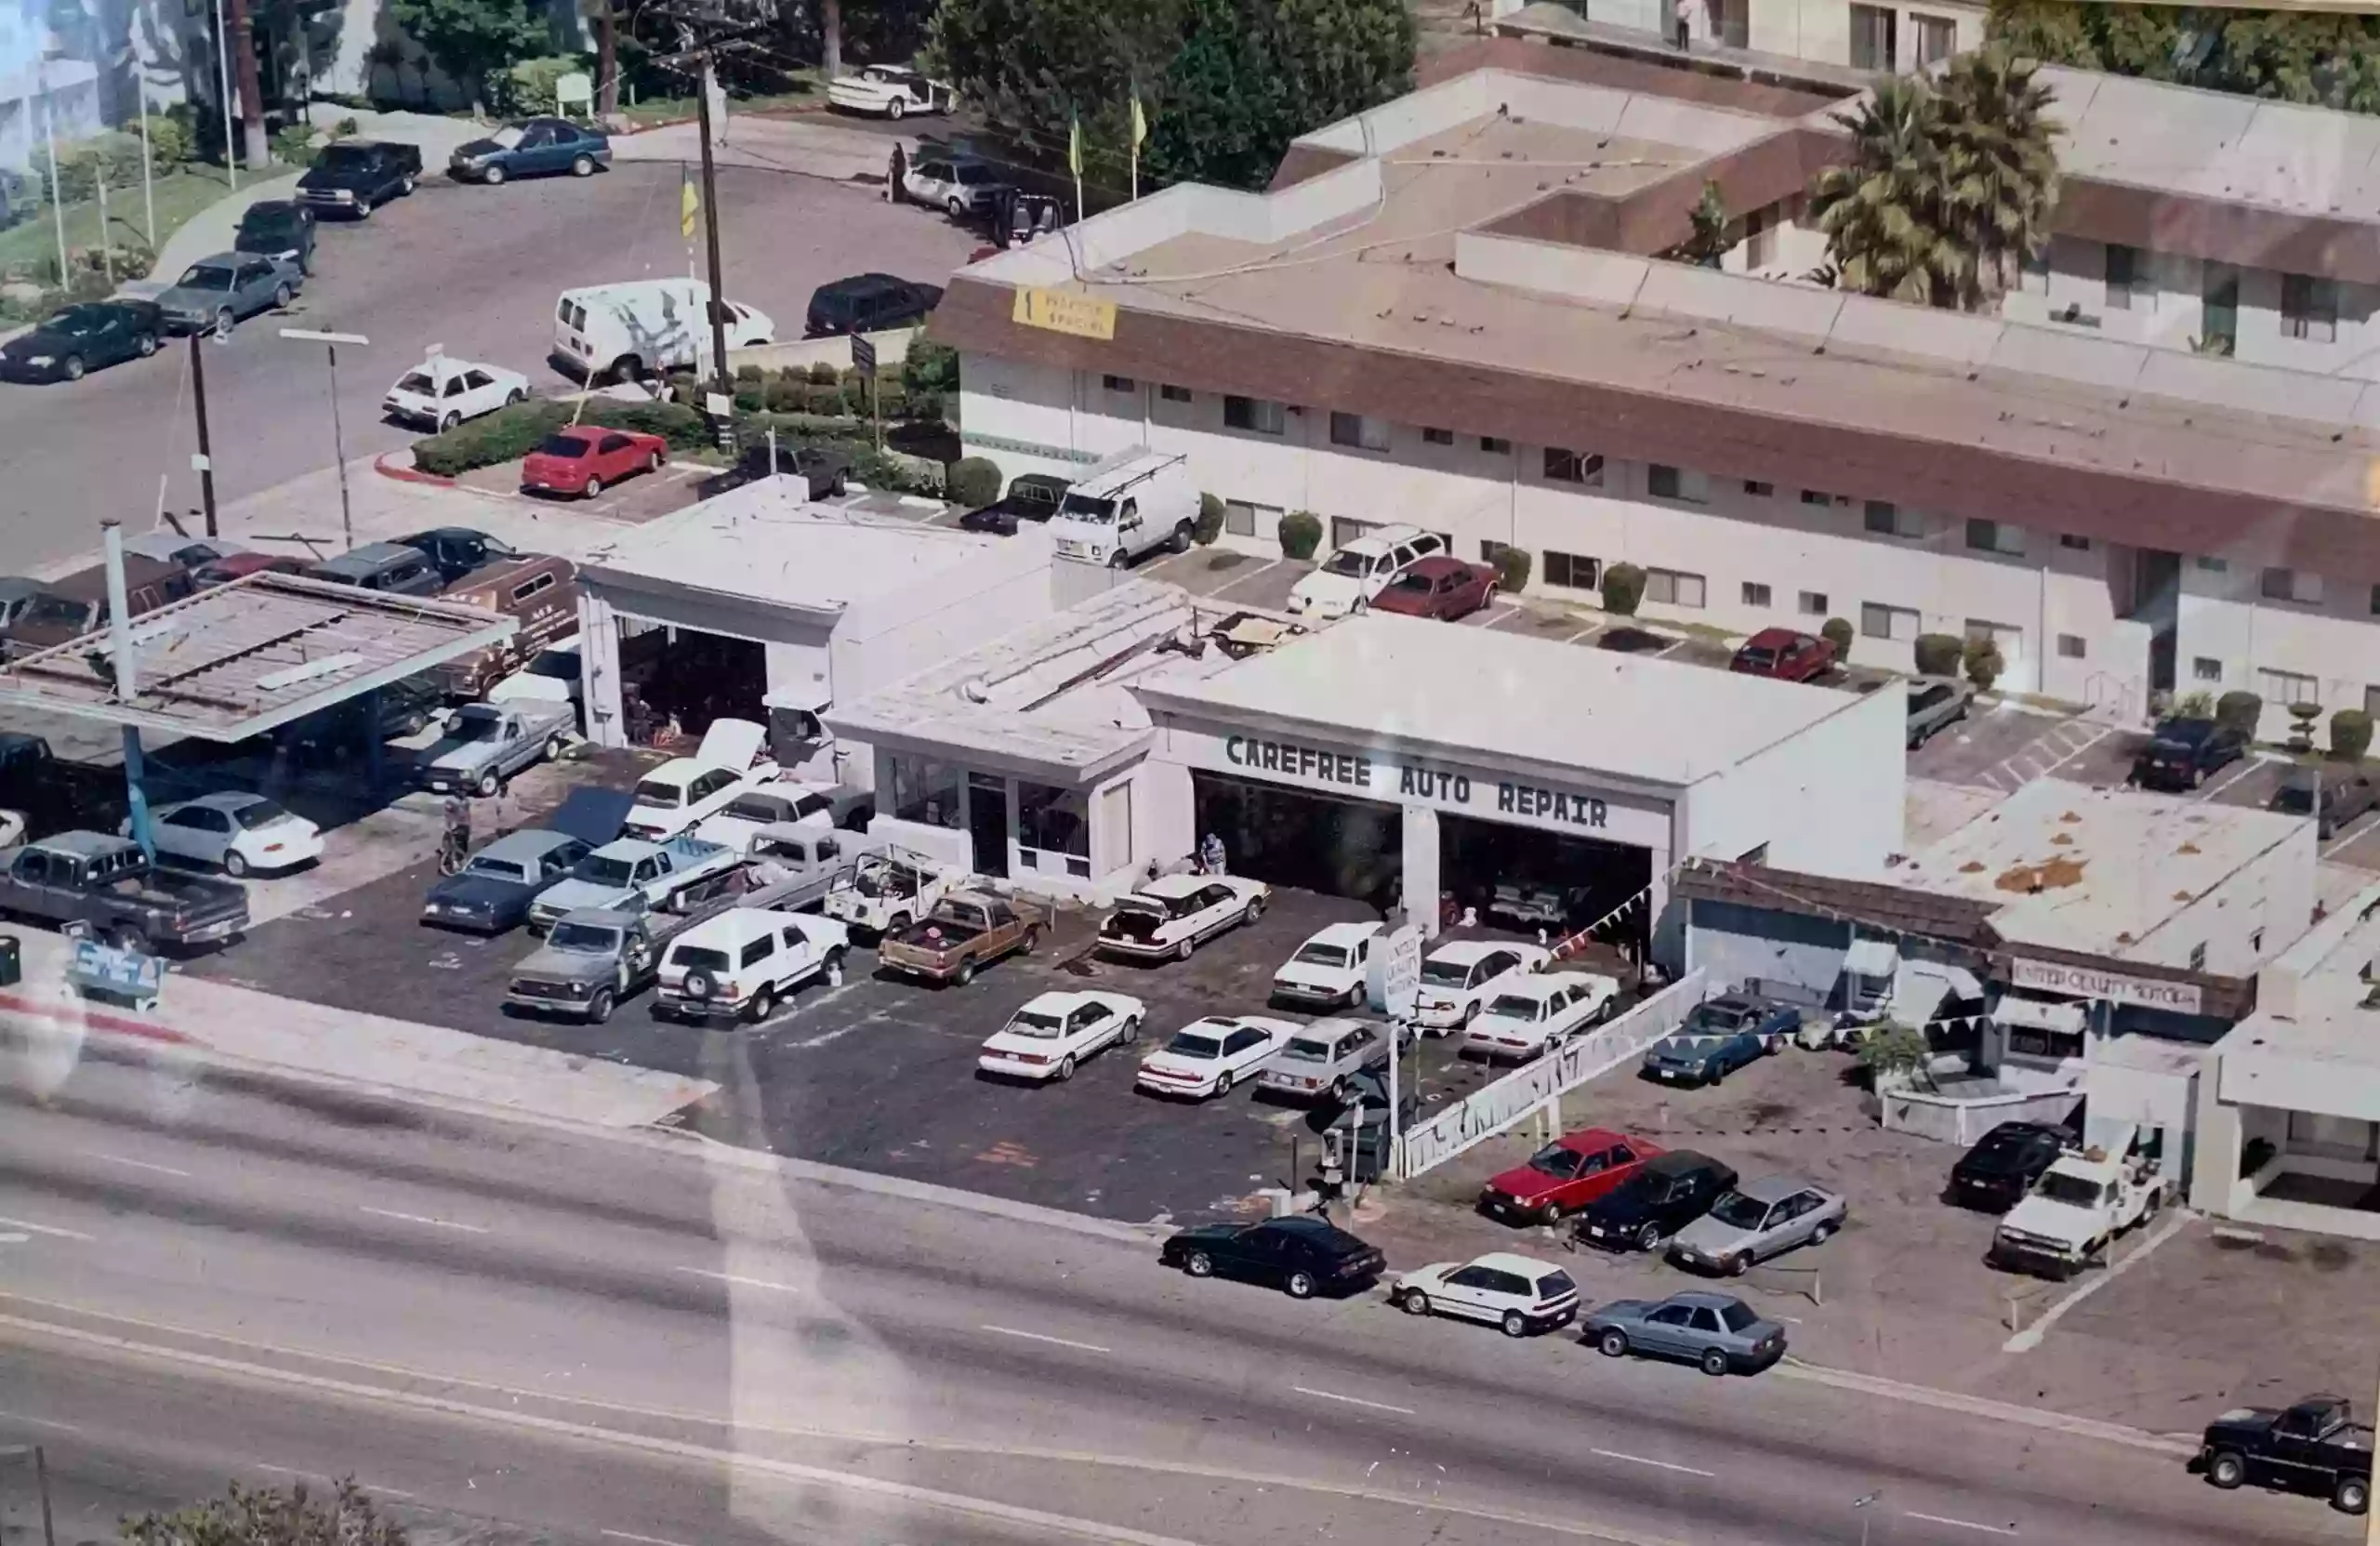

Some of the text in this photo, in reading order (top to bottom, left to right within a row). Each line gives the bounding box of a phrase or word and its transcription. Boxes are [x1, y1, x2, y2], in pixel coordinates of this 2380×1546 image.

[1226, 735, 1607, 828] CAREFREE AUTO REPAIR
